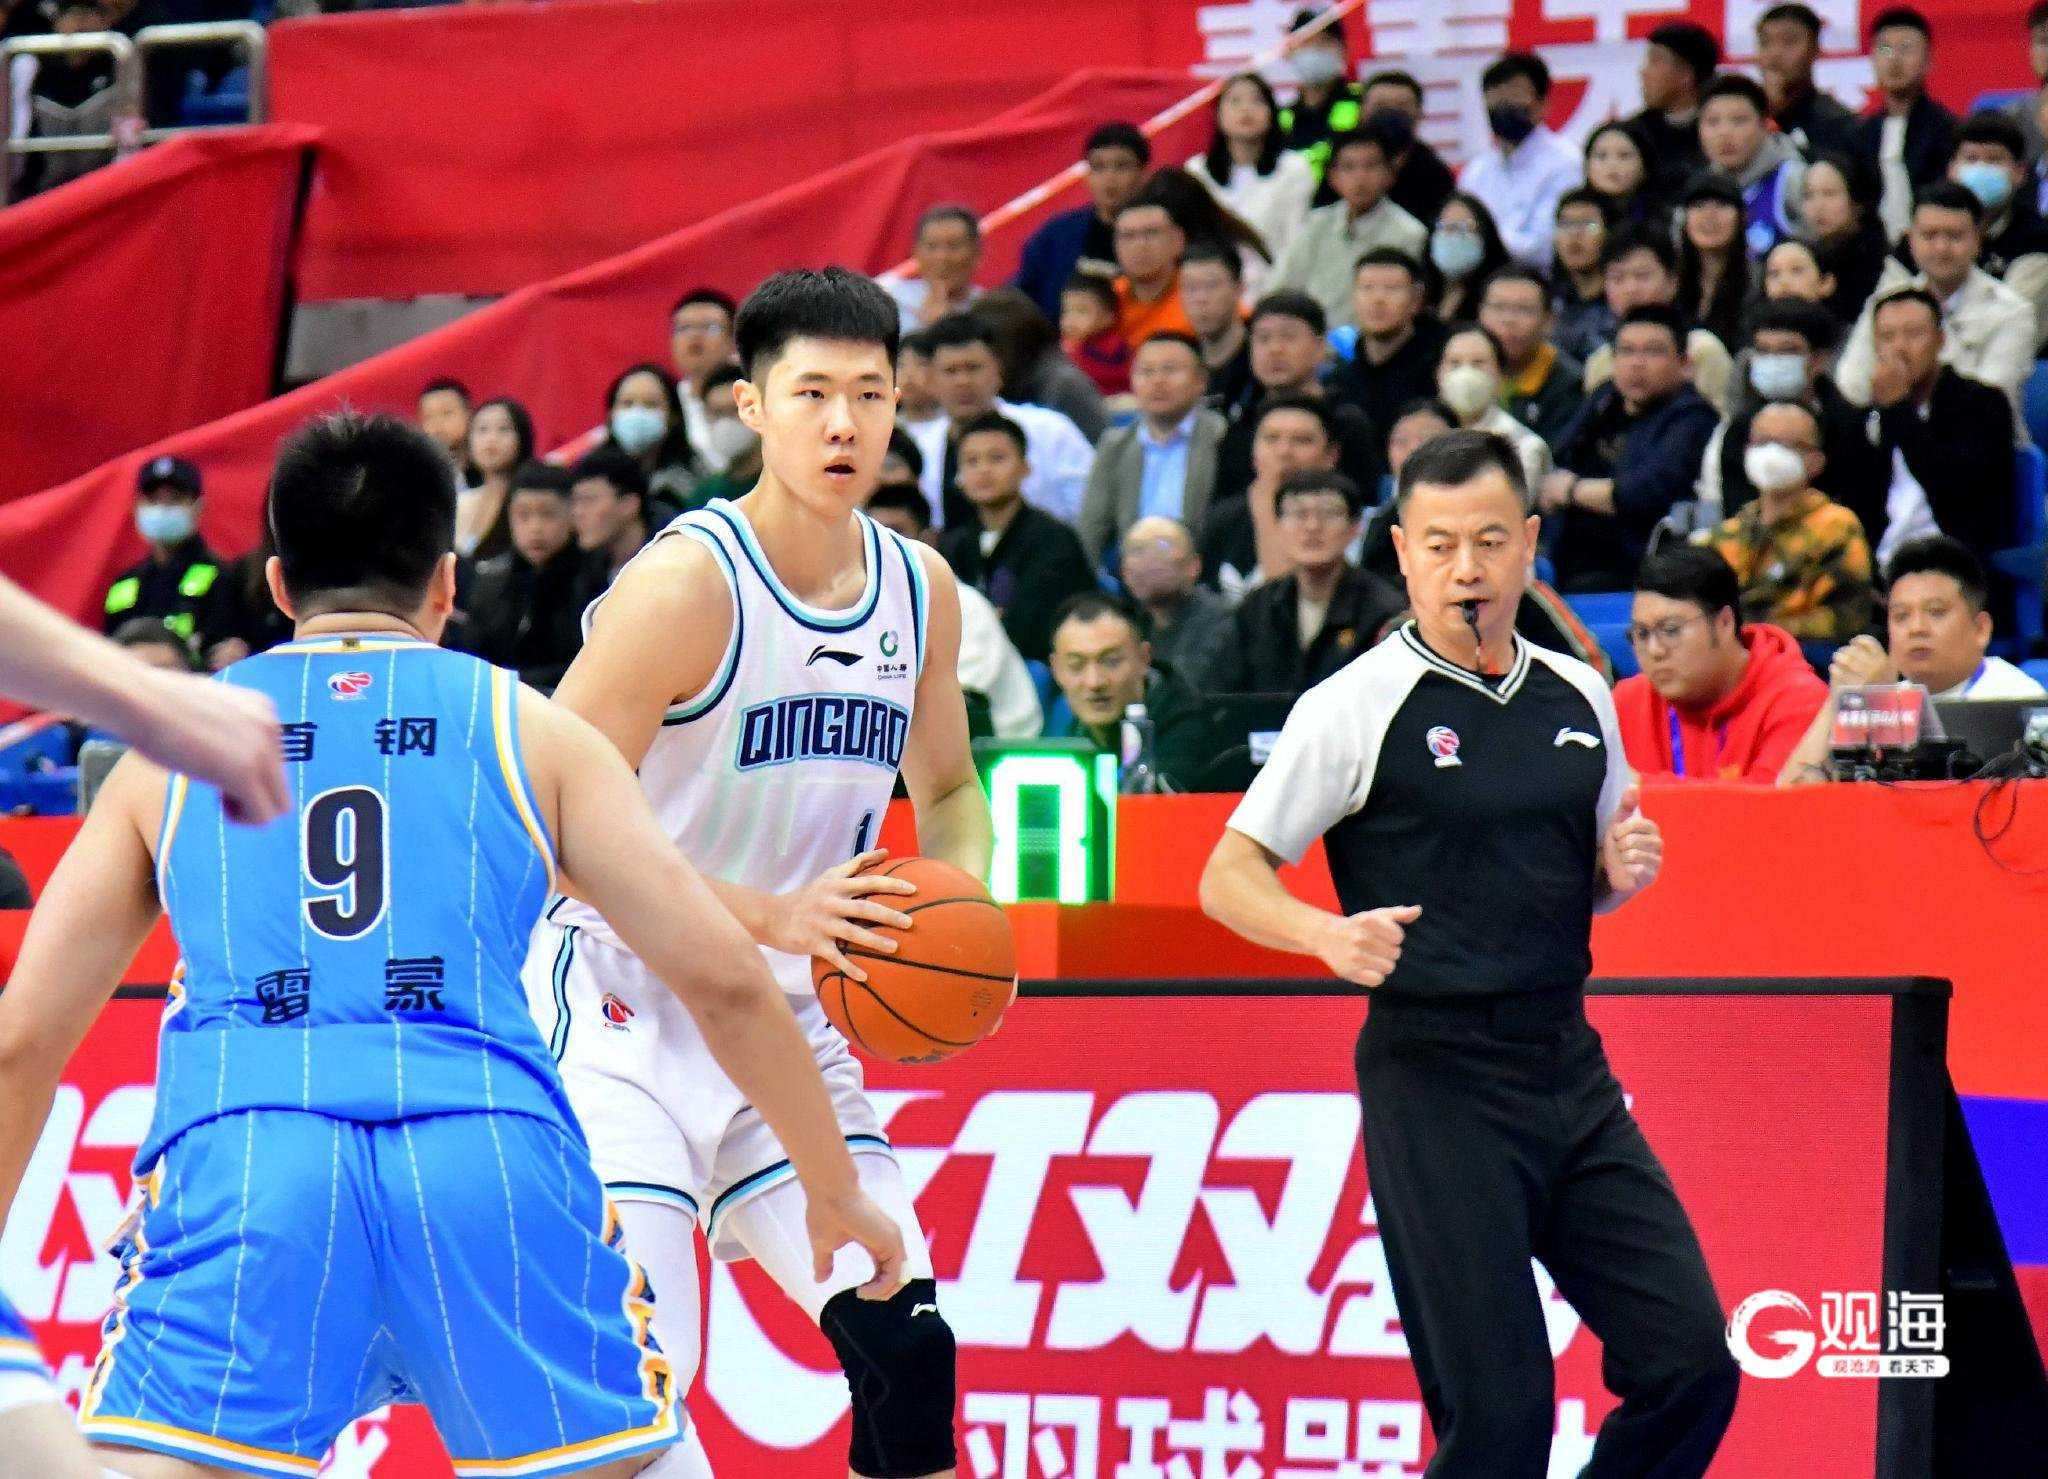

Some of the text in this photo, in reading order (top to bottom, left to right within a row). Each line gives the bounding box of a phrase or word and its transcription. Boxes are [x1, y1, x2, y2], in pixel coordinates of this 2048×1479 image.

[737, 696, 909, 771] QINGDAO
[303, 785, 391, 941] 9
[255, 955, 446, 1024] 雷蒙
